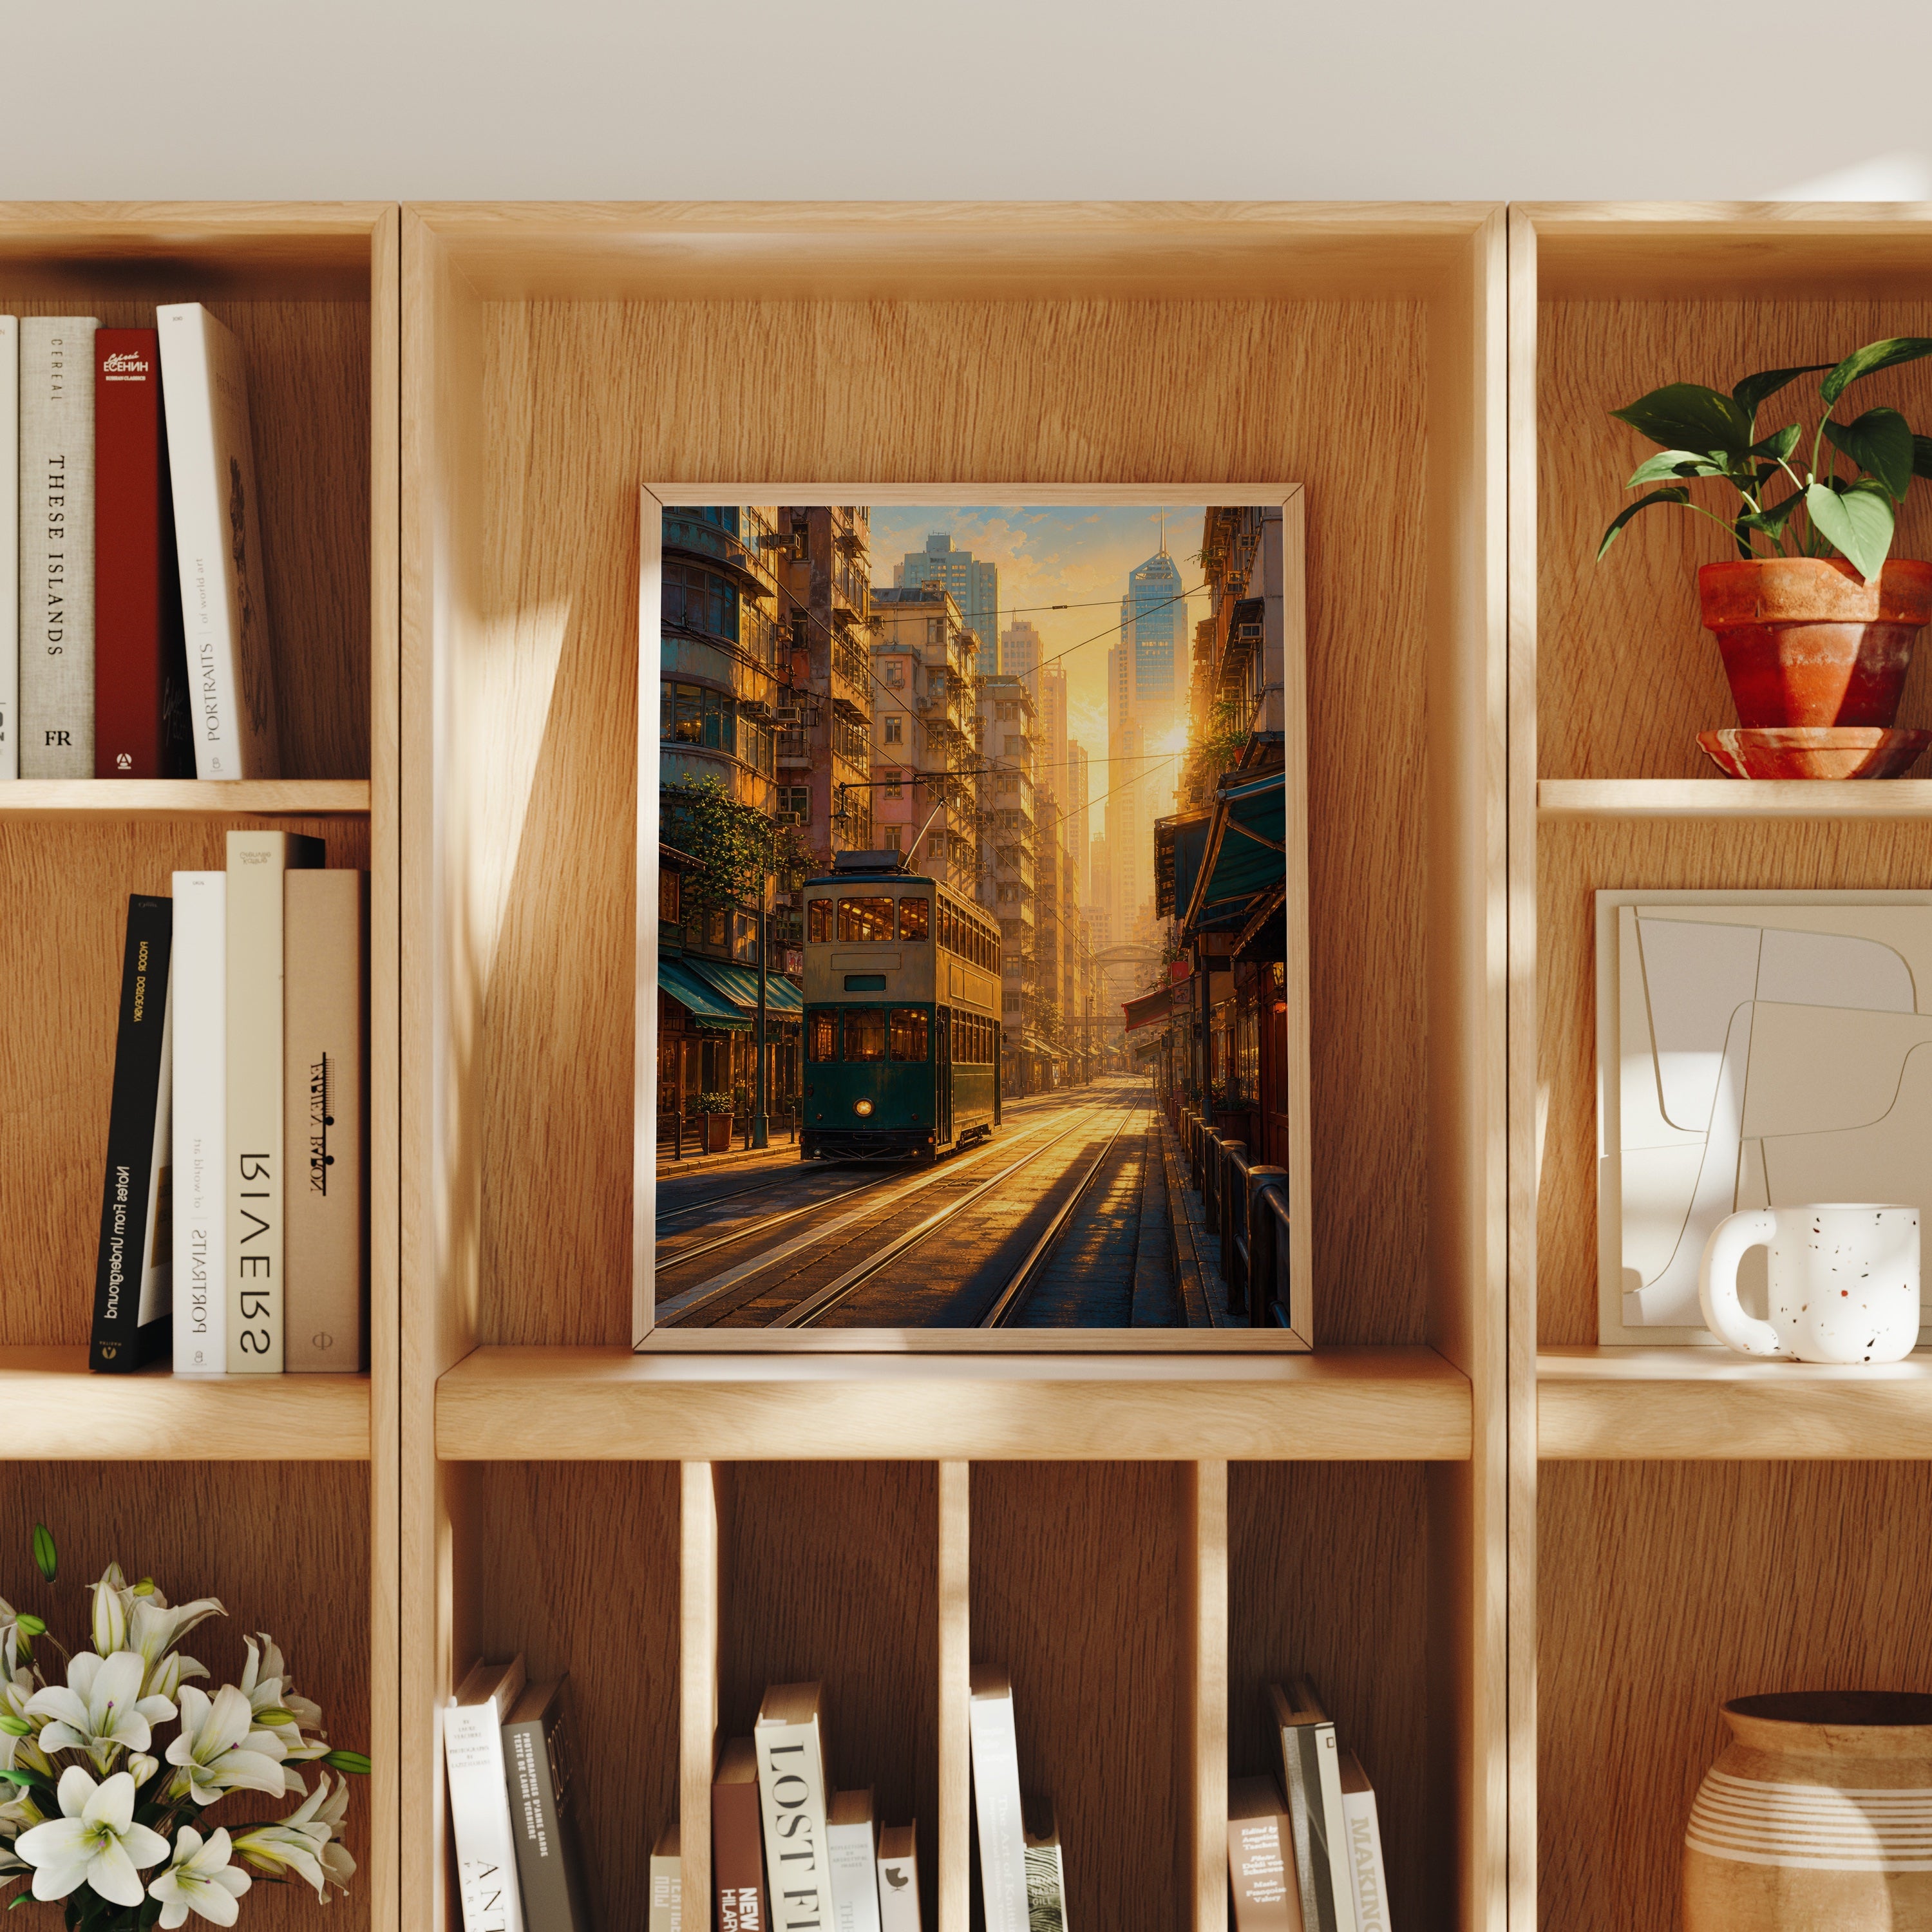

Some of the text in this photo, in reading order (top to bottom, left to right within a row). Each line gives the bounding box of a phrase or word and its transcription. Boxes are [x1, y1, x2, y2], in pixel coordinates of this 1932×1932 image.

[51, 339, 63, 401] CEREAL
[103, 361, 149, 372] ЕСЕНИН
[48, 455, 65, 656] THESE ISLANDS
[196, 558, 220, 741] PORTRAITS of world art
[44, 730, 72, 746] FR
[513, 1734, 525, 1759] TEXTE
[517, 1760, 526, 1772] DE
[519, 1774, 531, 1799] LAURE
[522, 1732, 549, 1857] PHOTOGRAPHIES D'ANNE GARDE
[769, 1741, 816, 1872] LOST
[654, 1876, 670, 1908] NOW
[1032, 1897, 1052, 1906] GILL
[739, 1888, 759, 1931] NEW
